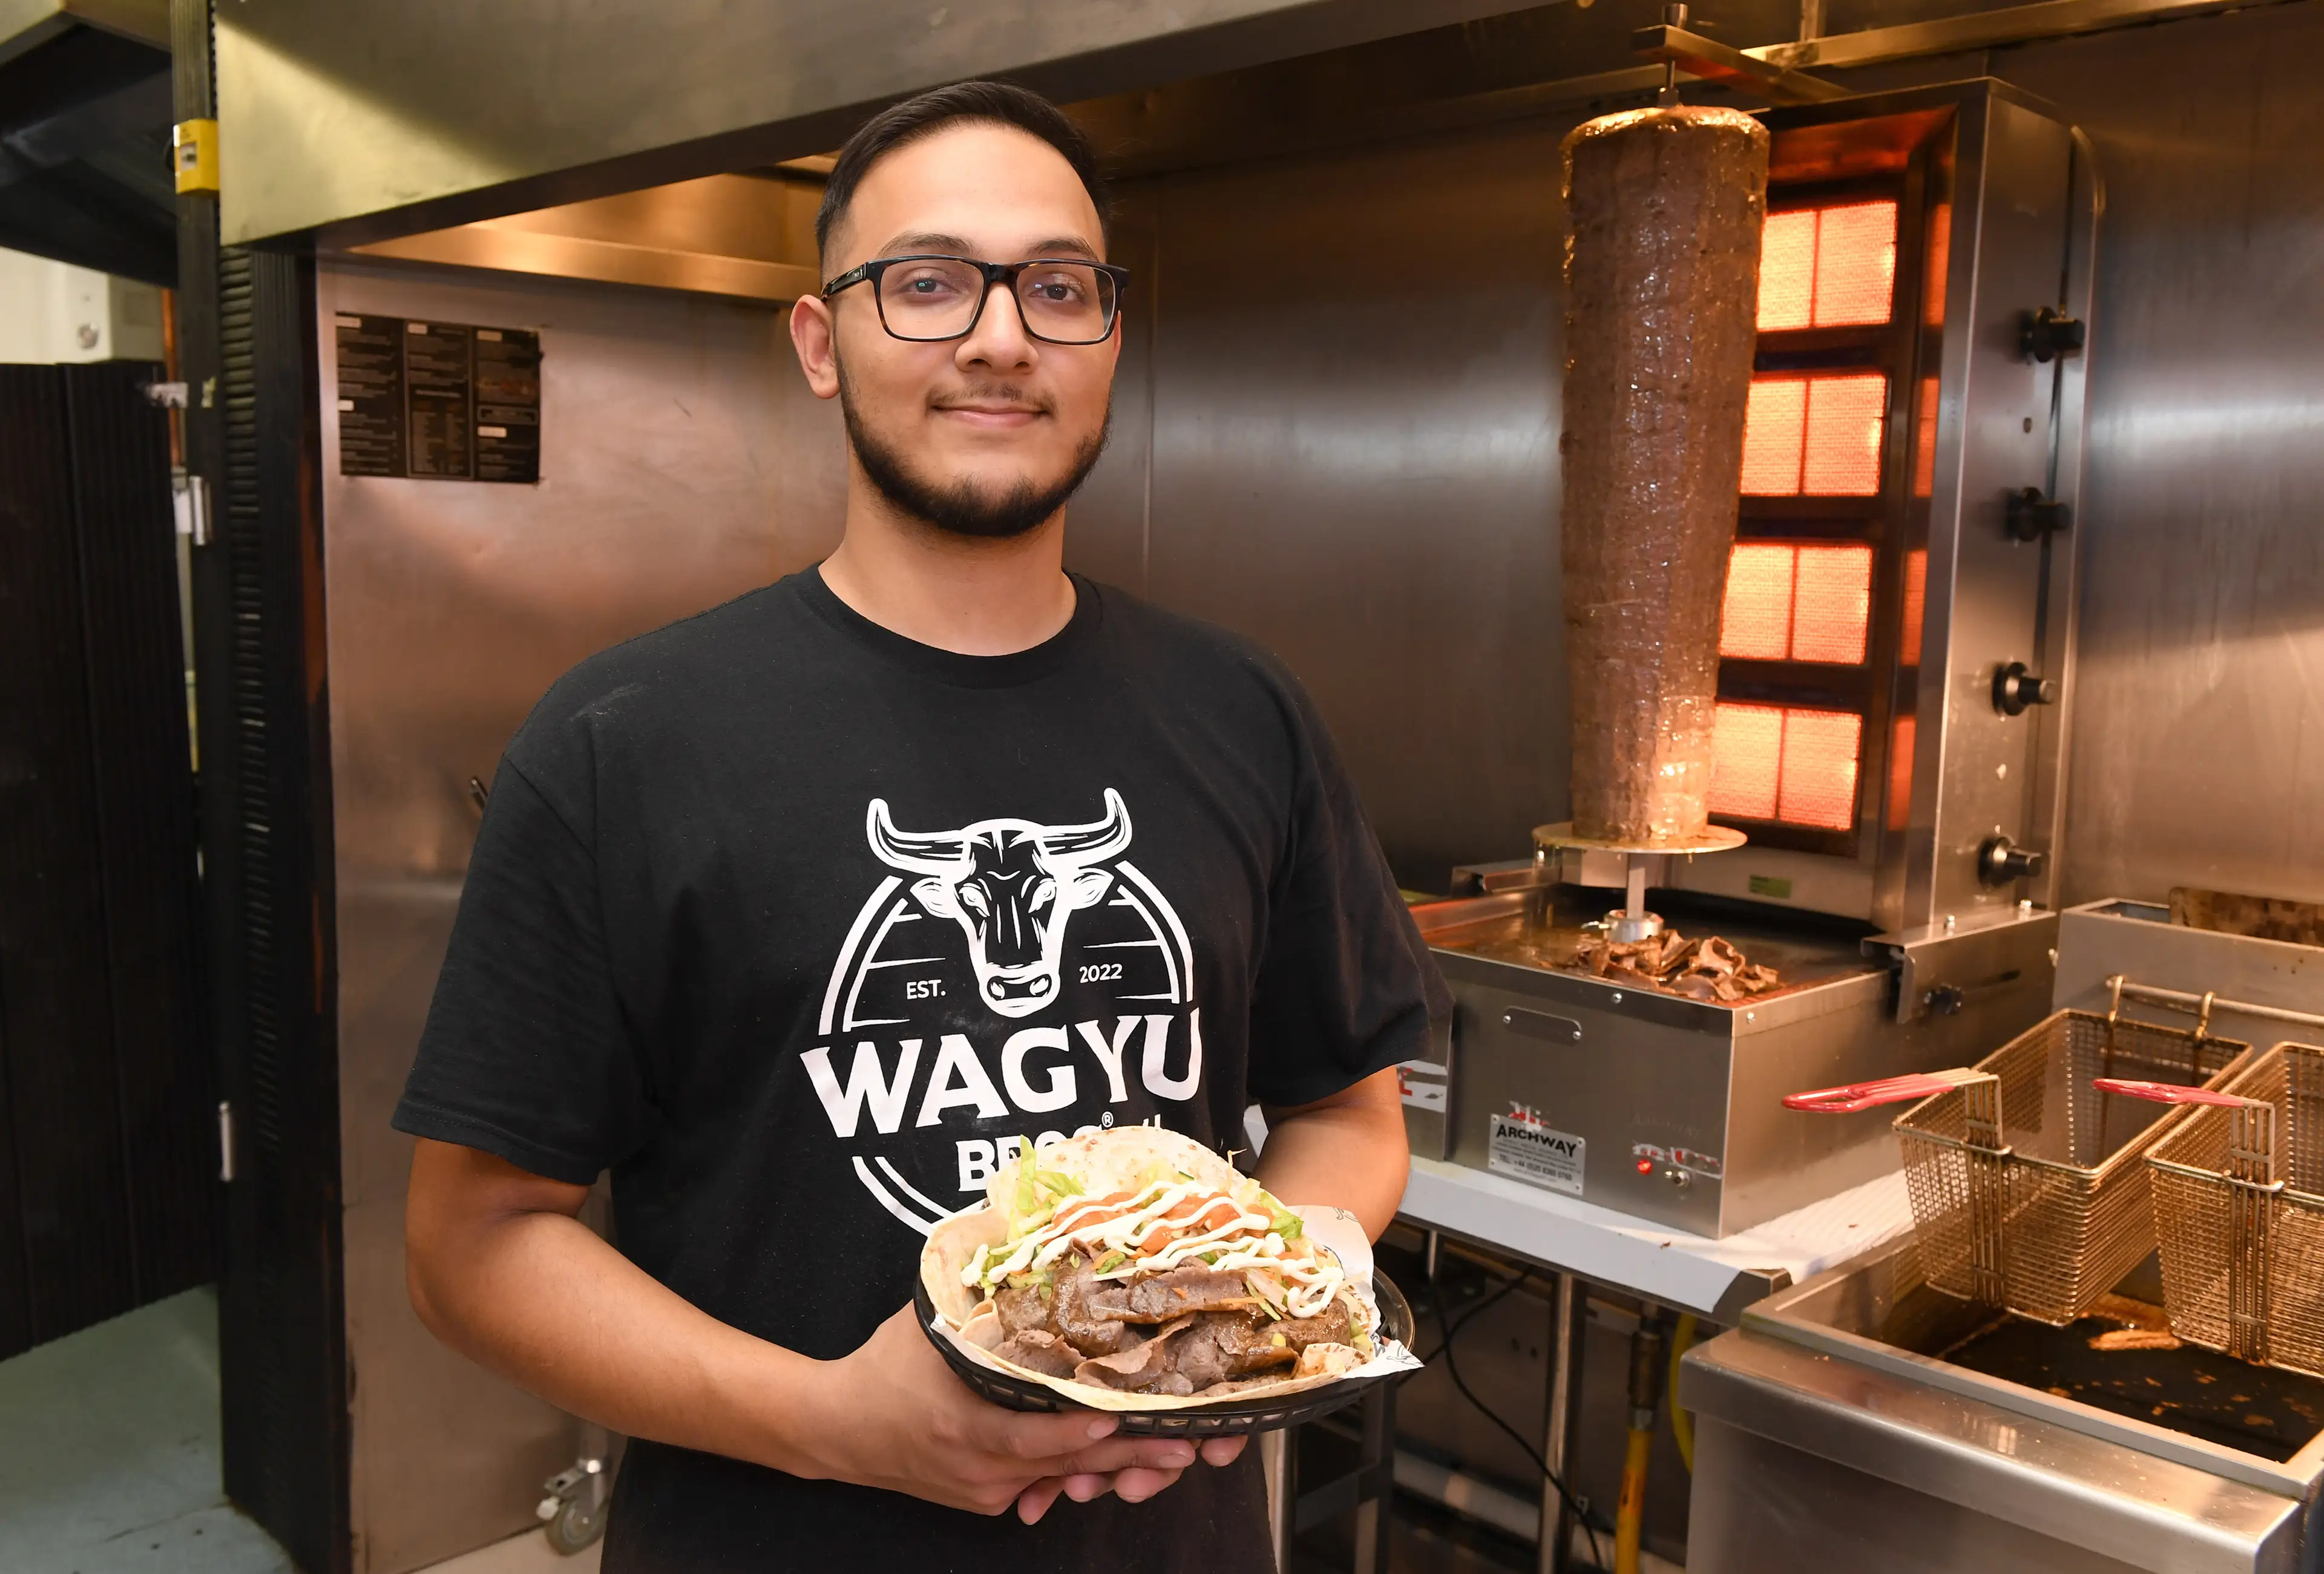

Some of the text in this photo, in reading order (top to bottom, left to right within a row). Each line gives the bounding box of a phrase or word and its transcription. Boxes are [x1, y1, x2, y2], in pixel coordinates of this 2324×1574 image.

[1079, 963, 1123, 983] 2022
[907, 979, 947, 1000] EST.
[799, 1007, 1203, 1138] WAGYU
[1496, 1124, 1577, 1158] ARCHWAY
